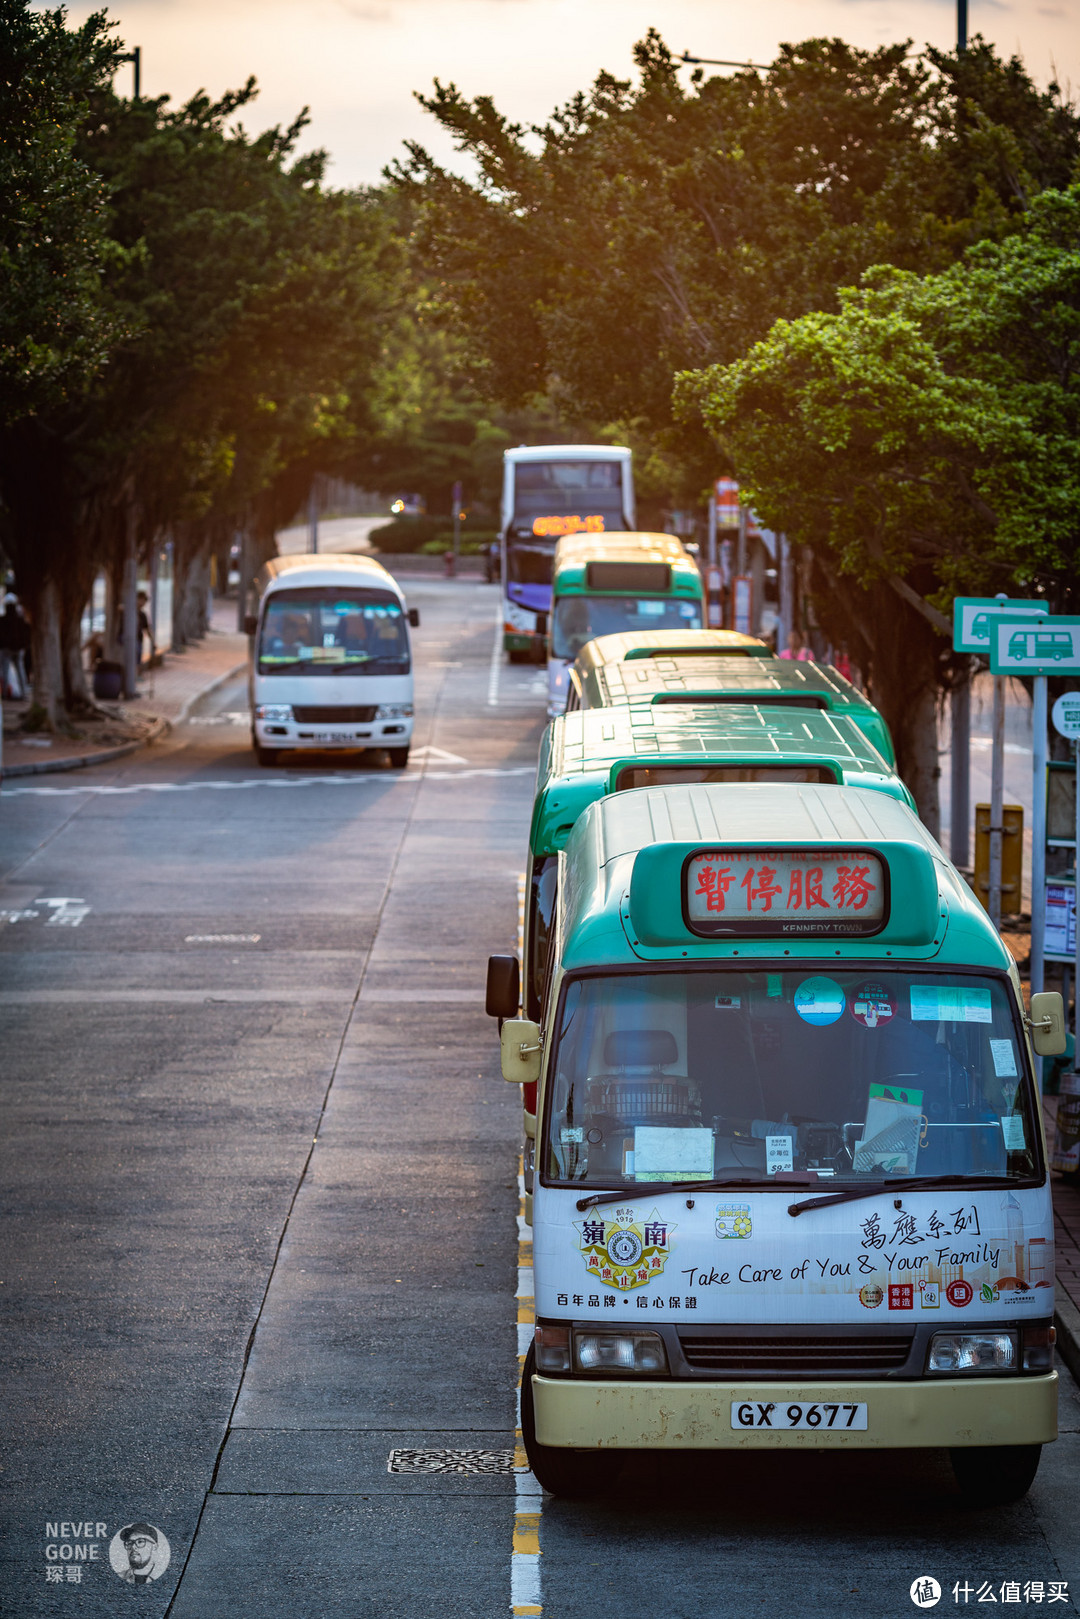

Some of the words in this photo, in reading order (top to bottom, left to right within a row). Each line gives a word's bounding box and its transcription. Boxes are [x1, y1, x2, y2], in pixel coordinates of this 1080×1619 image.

[694, 865, 877, 913] 暫停服務
[615, 1216, 634, 1224] 1919
[859, 1205, 982, 1250] 萬應系列
[681, 1266, 731, 1288] Take
[738, 1264, 782, 1283] Care
[790, 1259, 811, 1281] of
[816, 1257, 851, 1277] You
[858, 1254, 878, 1274] &
[883, 1251, 929, 1271] Your
[935, 1243, 1001, 1269] Family
[892, 1287, 911, 1297] 香港
[892, 1298, 911, 1307] 製造
[738, 1404, 772, 1426] GX
[787, 1404, 859, 1427] 9677
